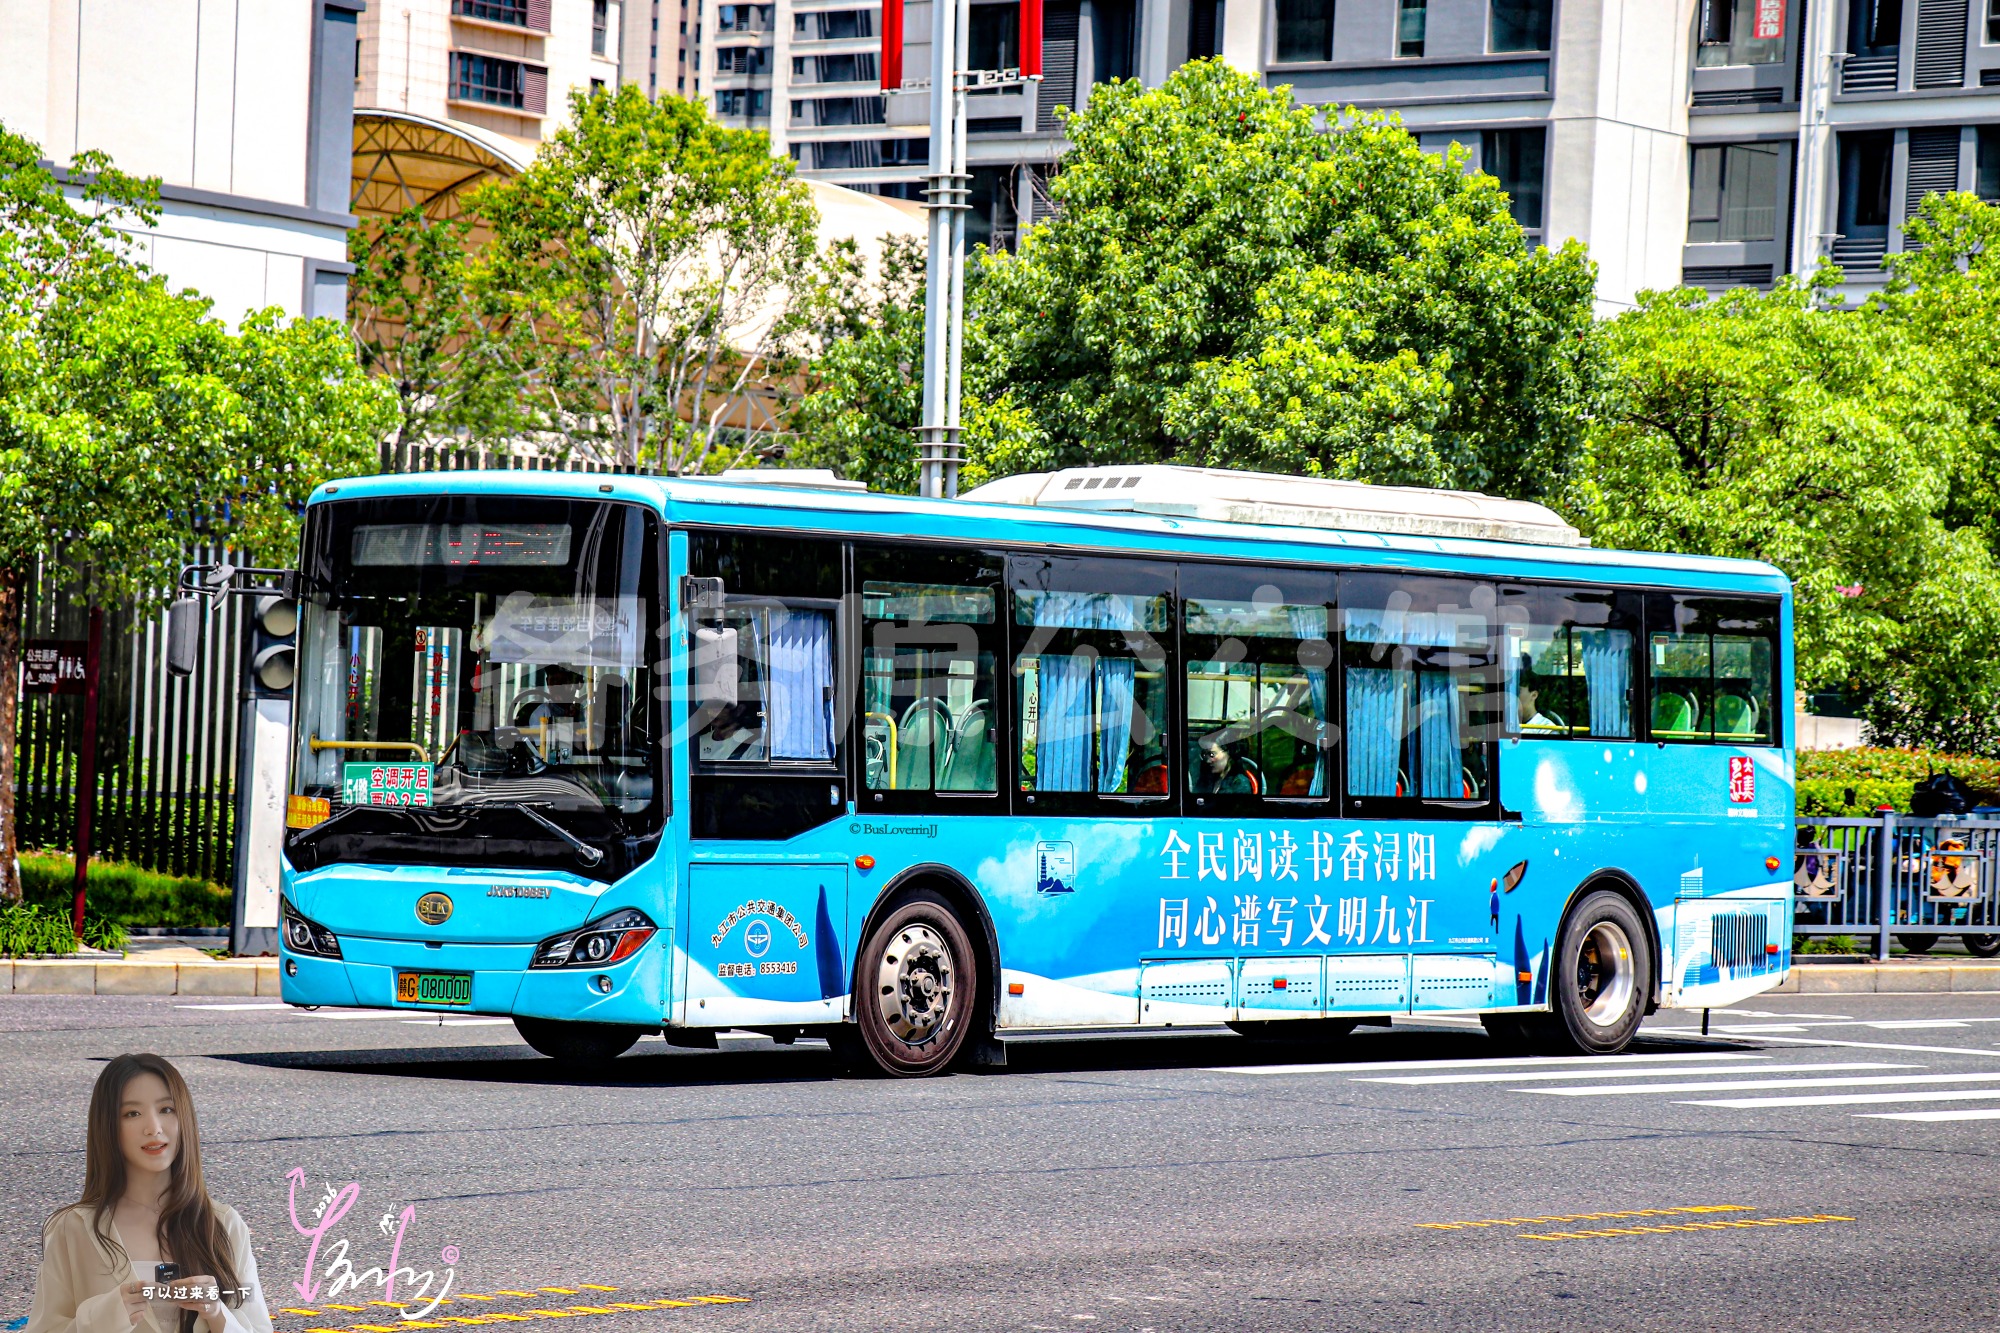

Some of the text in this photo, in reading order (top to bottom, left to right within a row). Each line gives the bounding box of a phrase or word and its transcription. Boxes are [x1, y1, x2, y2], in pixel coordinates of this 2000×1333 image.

[346, 653, 360, 719] 小心开门
[371, 767, 429, 789] 空调开启
[1160, 829, 1436, 882] 全民阅读书香浔阳
[420, 901, 447, 914] BLK
[711, 899, 809, 948] 九江市公共交通集团公司
[1157, 894, 1435, 948] 同心谱写文明九江
[760, 963, 797, 974] 8553416
